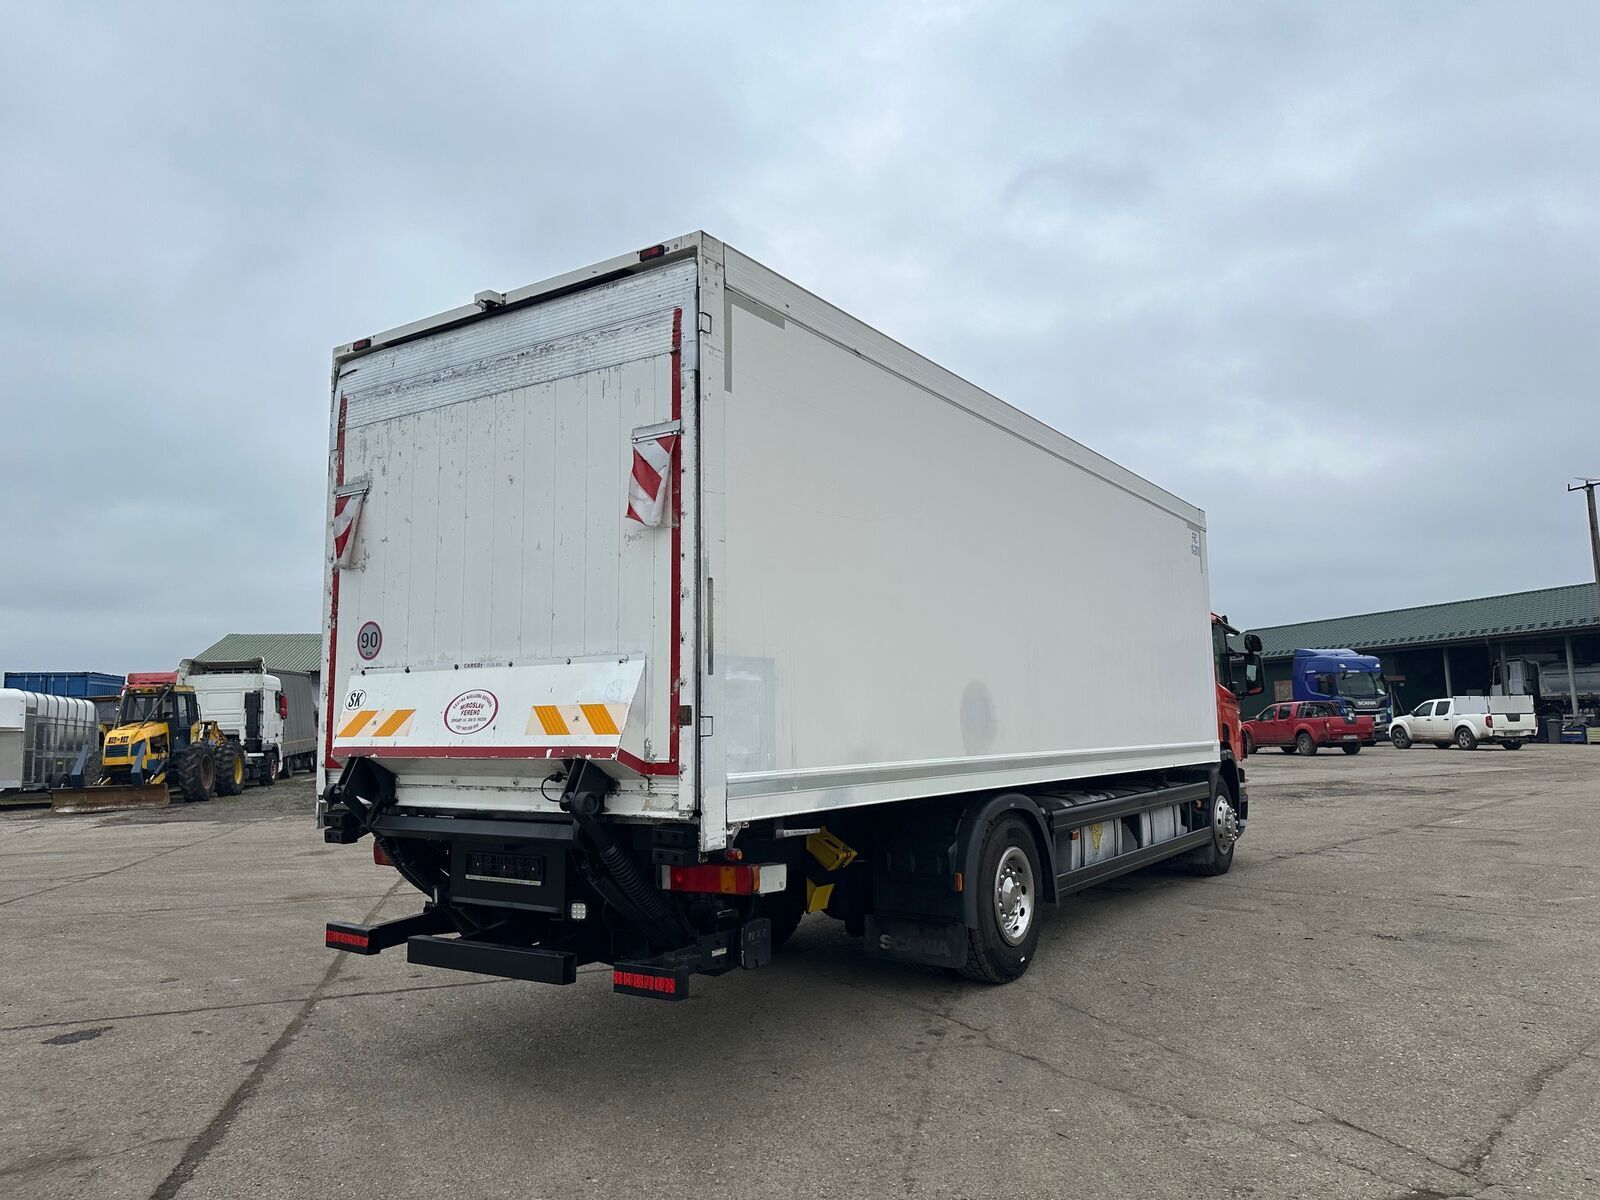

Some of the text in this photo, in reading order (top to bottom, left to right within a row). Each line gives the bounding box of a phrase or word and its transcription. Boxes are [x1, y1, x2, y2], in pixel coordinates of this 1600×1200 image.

[361, 631, 378, 649] 90
[348, 692, 363, 708] SK
[460, 702, 485, 710] MIROSLAV
